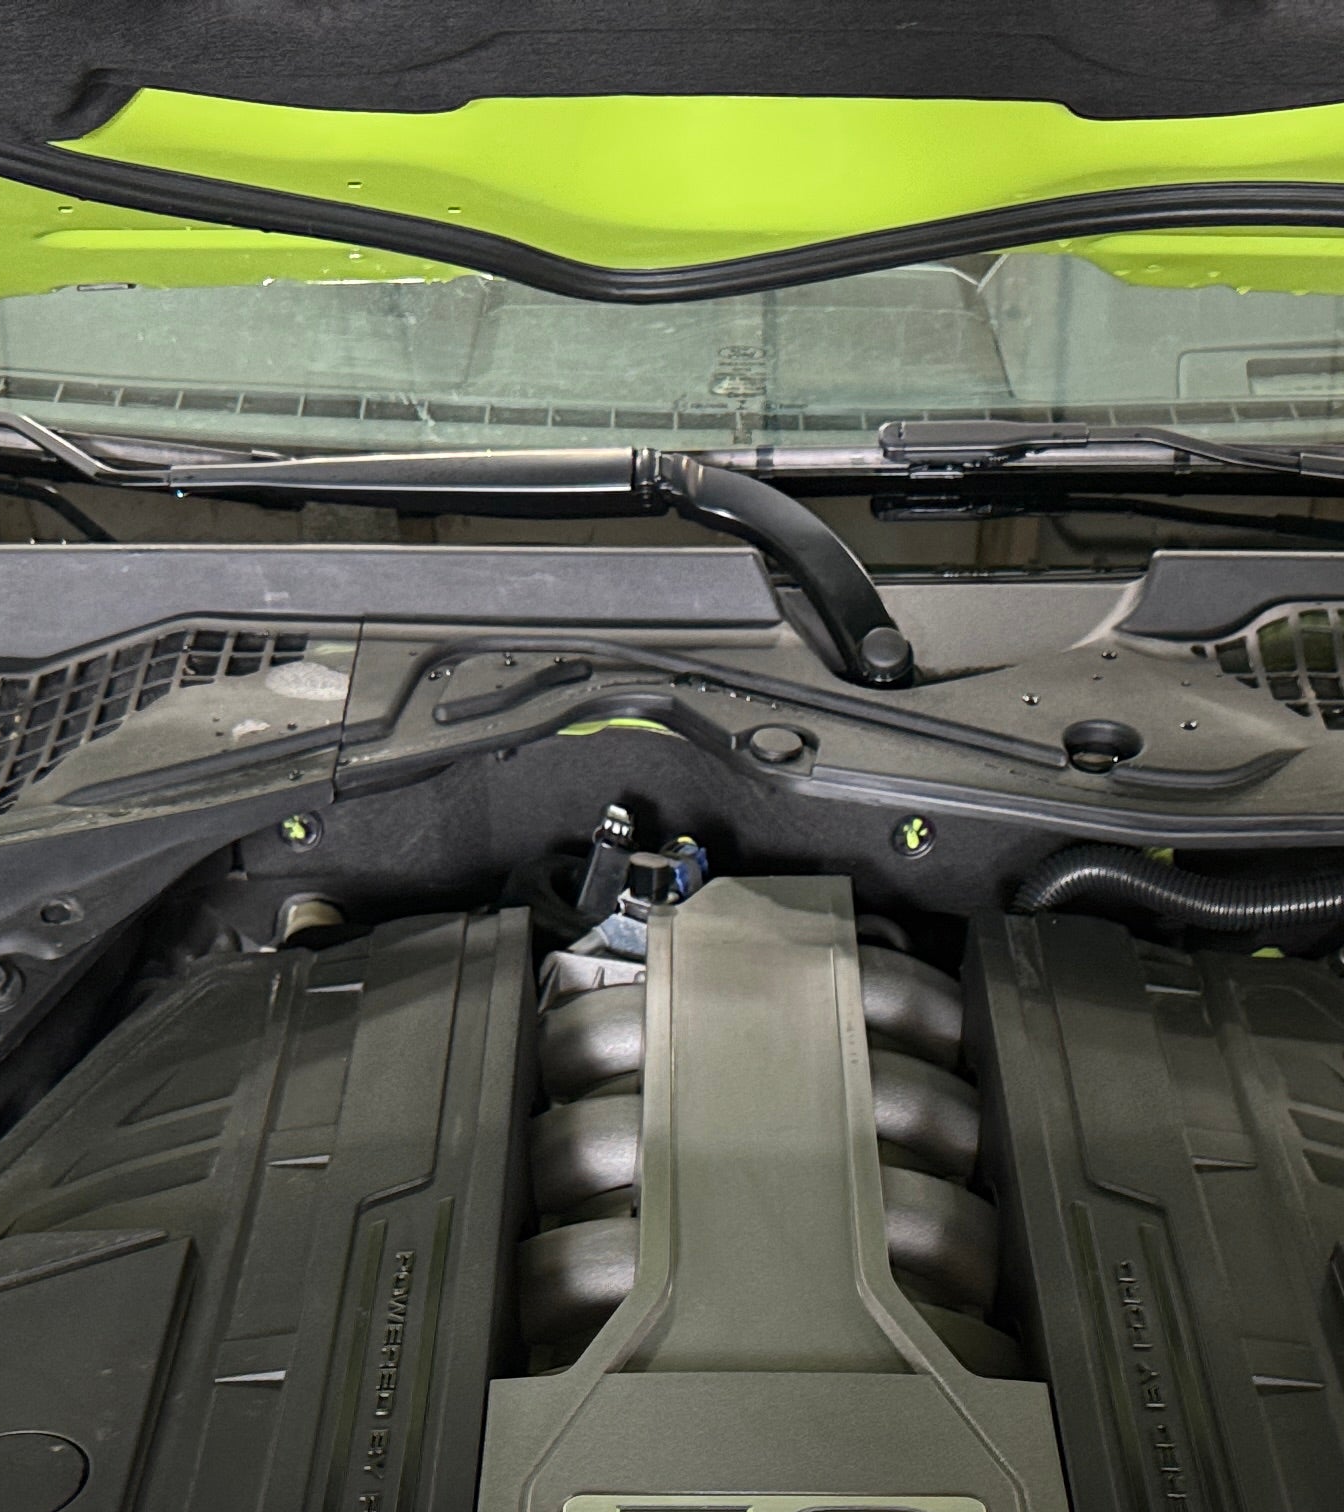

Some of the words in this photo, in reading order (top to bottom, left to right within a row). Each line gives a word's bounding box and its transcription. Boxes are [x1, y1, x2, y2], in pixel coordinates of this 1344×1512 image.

[373, 1250, 417, 1417] POWERED
[1119, 1260, 1154, 1349] FORD
[363, 1428, 389, 1480] BY
